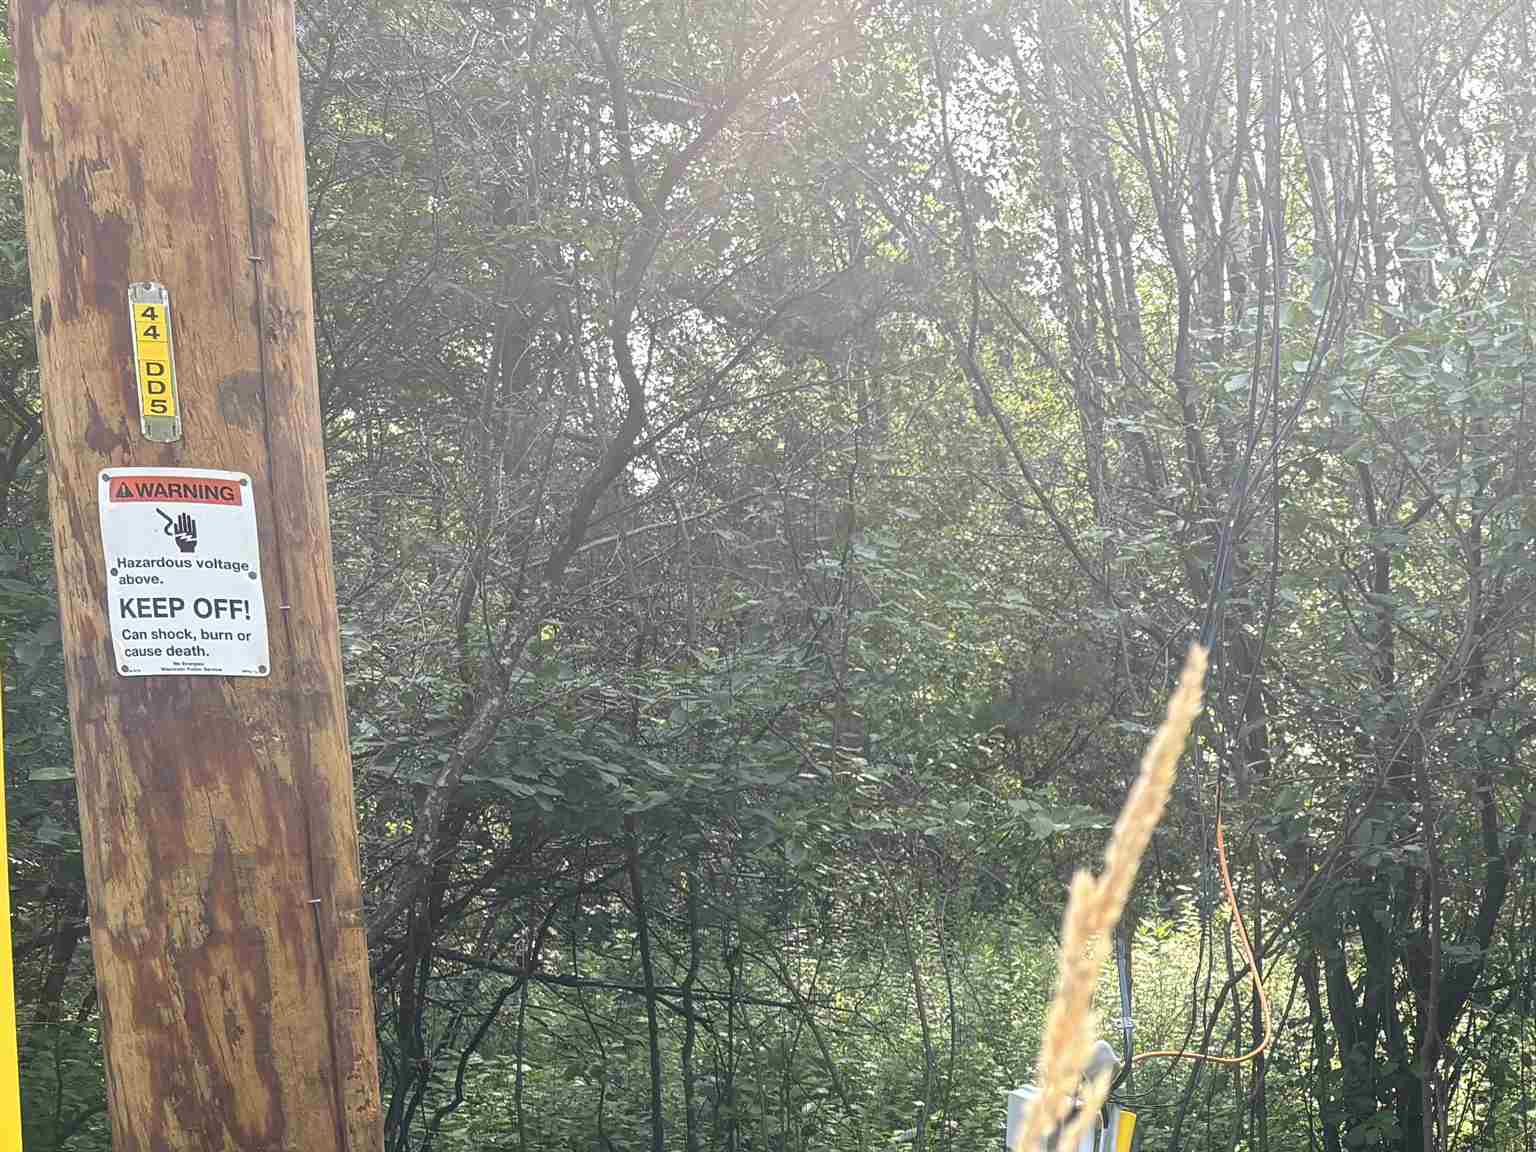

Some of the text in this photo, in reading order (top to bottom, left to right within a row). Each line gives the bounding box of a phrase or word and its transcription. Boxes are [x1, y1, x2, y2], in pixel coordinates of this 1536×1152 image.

[135, 482, 235, 501] WARNING
[117, 557, 249, 572] Hazardous voltage
[118, 574, 164, 585] above.
[120, 597, 251, 621] KEEP OFF!
[121, 628, 252, 642] Can shock, burn or
[124, 645, 210, 658] cause death.
